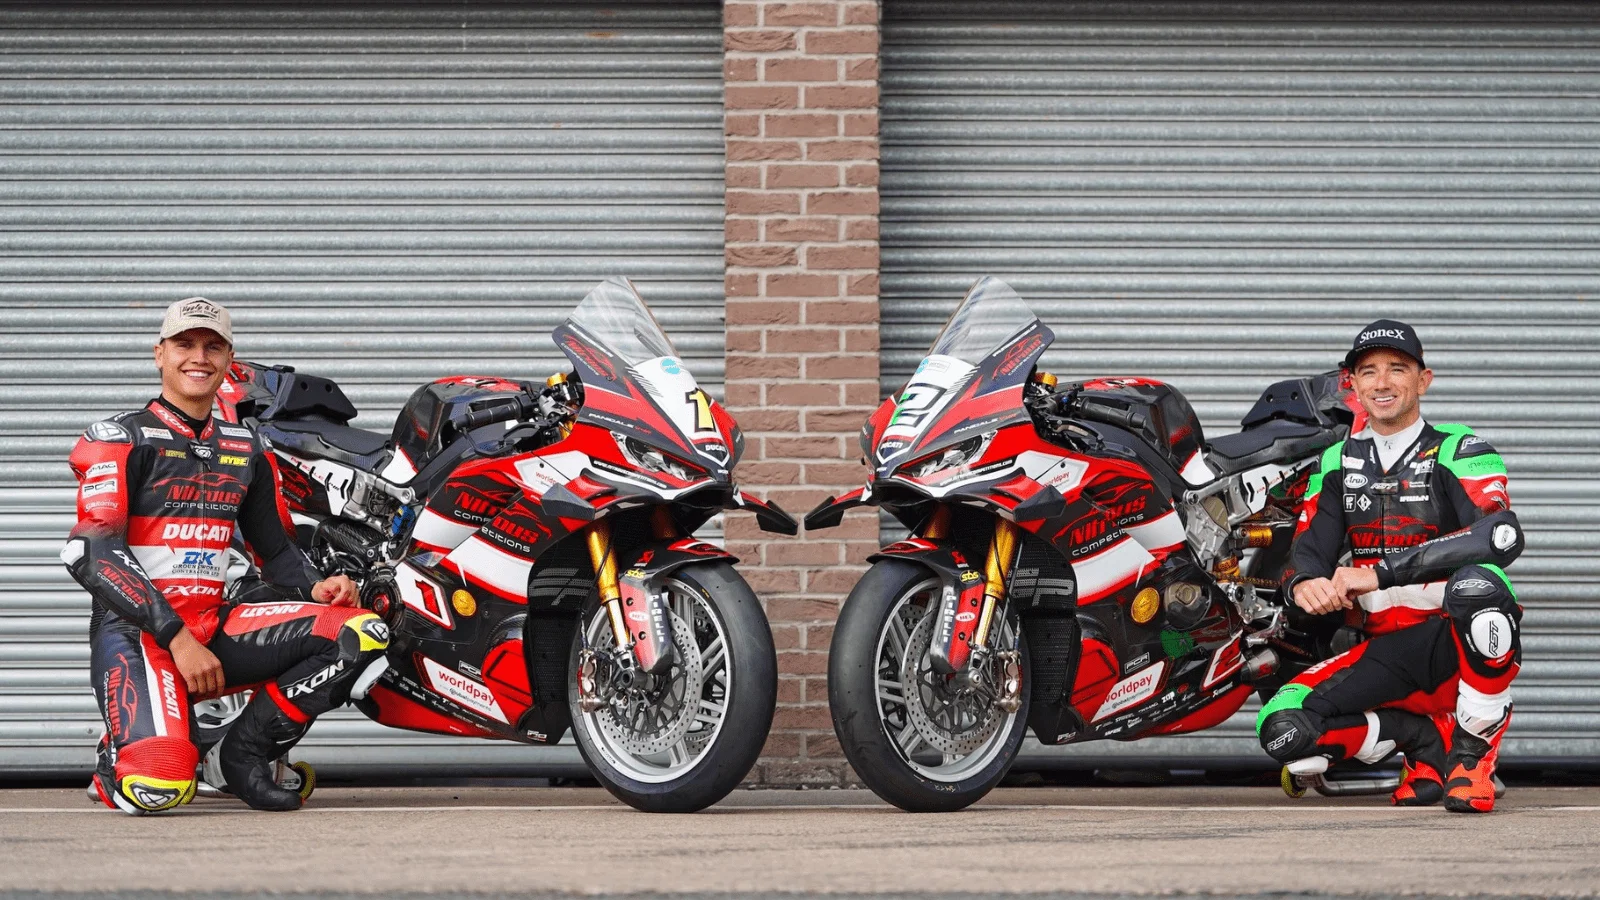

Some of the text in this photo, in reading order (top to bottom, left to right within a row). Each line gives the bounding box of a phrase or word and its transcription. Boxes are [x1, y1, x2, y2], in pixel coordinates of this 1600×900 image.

[1359, 328, 1406, 344] StoneX
[685, 387, 717, 433] 1
[588, 413, 634, 429] PANIGALE
[953, 417, 999, 434] PANIGALE
[84, 480, 116, 493] PCR
[164, 501, 239, 513] competitions
[162, 523, 231, 543] DUCATI
[454, 509, 531, 553] competitions
[1071, 513, 1144, 557] competitions
[172, 563, 221, 572] GROUNWORKS
[182, 551, 217, 566] DK
[960, 570, 980, 582] sbs
[1451, 578, 1495, 592] RST
[96, 571, 140, 609] competitions
[239, 604, 305, 619] DUCATI
[649, 594, 666, 642] PIRELLI
[942, 595, 957, 643] PIRELLI
[1488, 620, 1499, 657] RST
[161, 668, 181, 721] DUCATI
[438, 671, 495, 706] worldpay
[1266, 727, 1298, 752] RST
